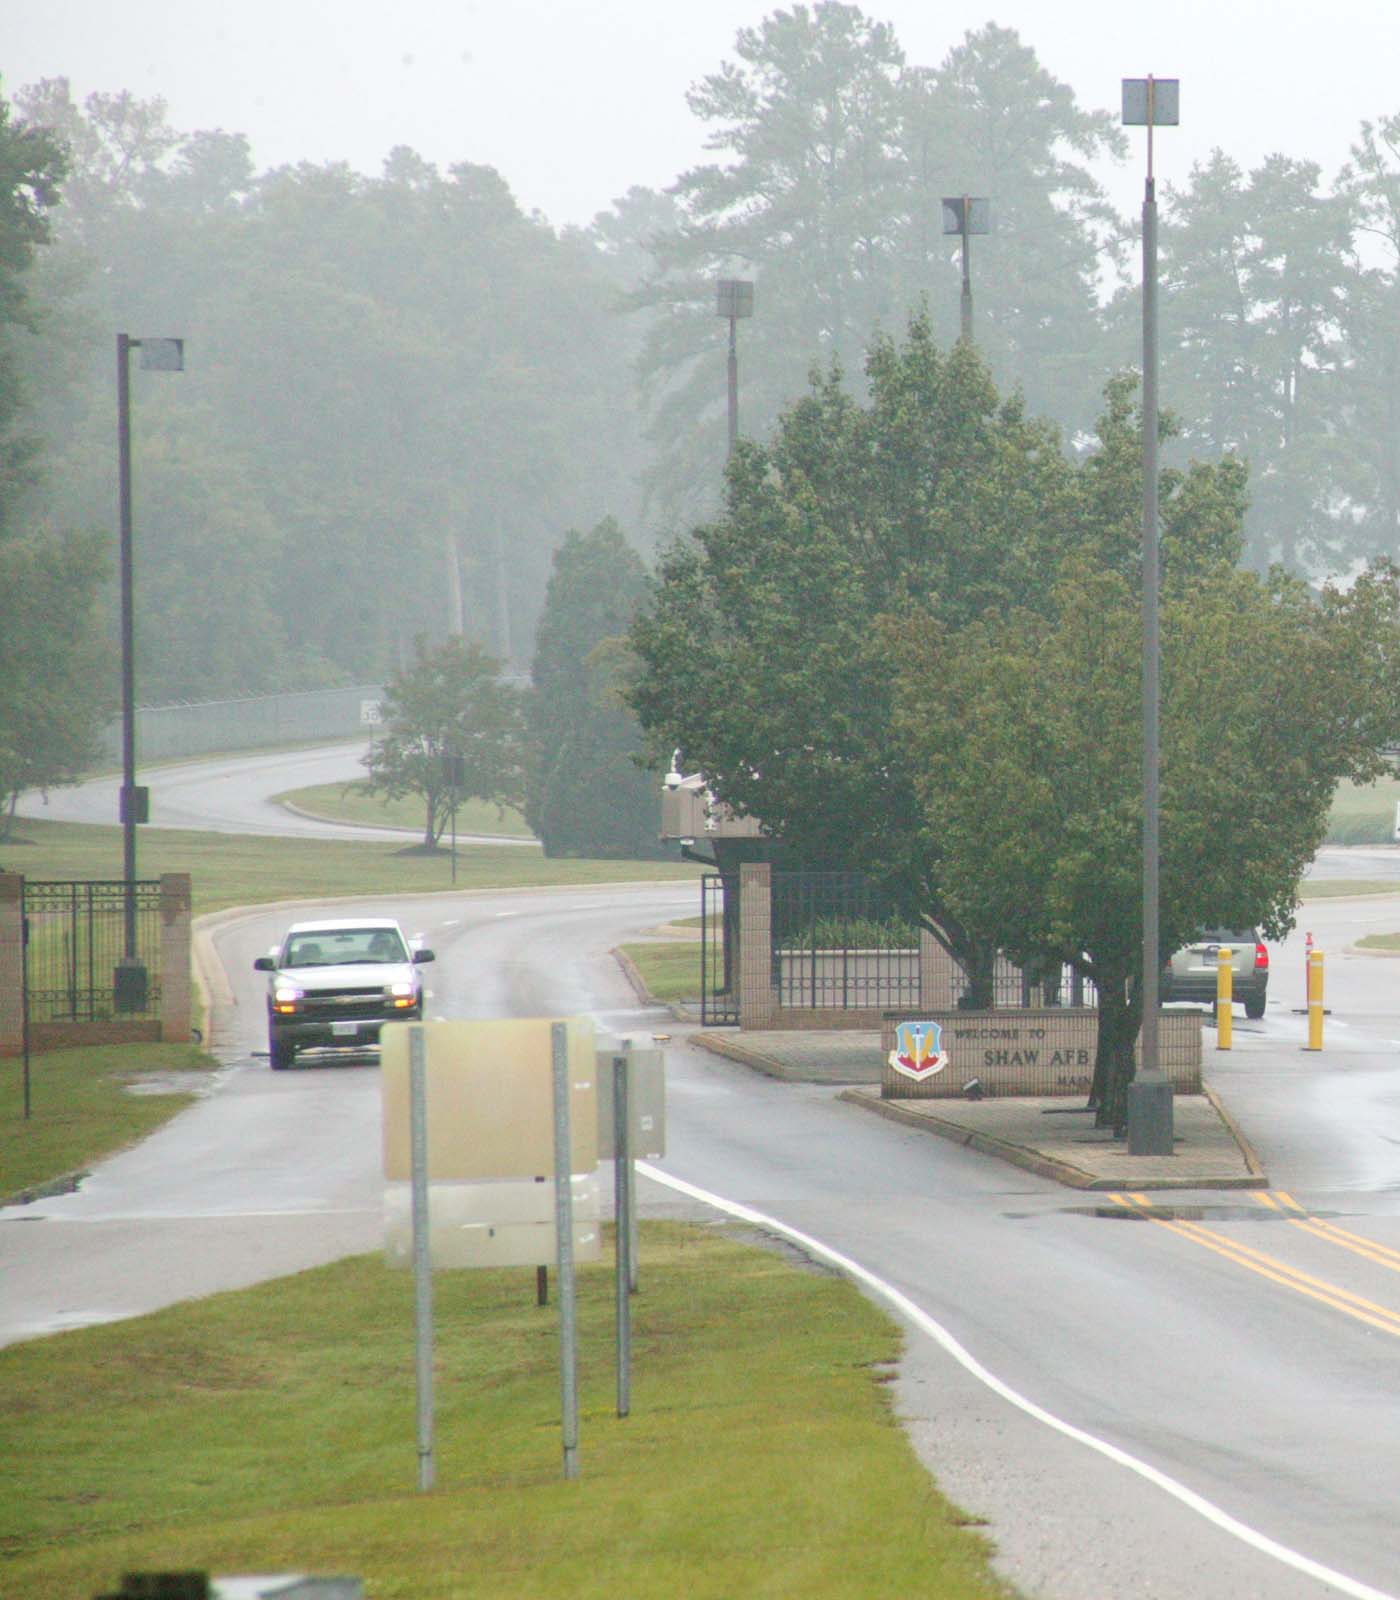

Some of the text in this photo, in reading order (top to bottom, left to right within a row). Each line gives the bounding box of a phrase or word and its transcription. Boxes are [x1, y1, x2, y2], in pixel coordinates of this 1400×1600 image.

[955, 1028, 1045, 1040] WELCOME TO
[984, 1050, 1089, 1066] SHAW AFB
[1057, 1075, 1092, 1086] MAIN
